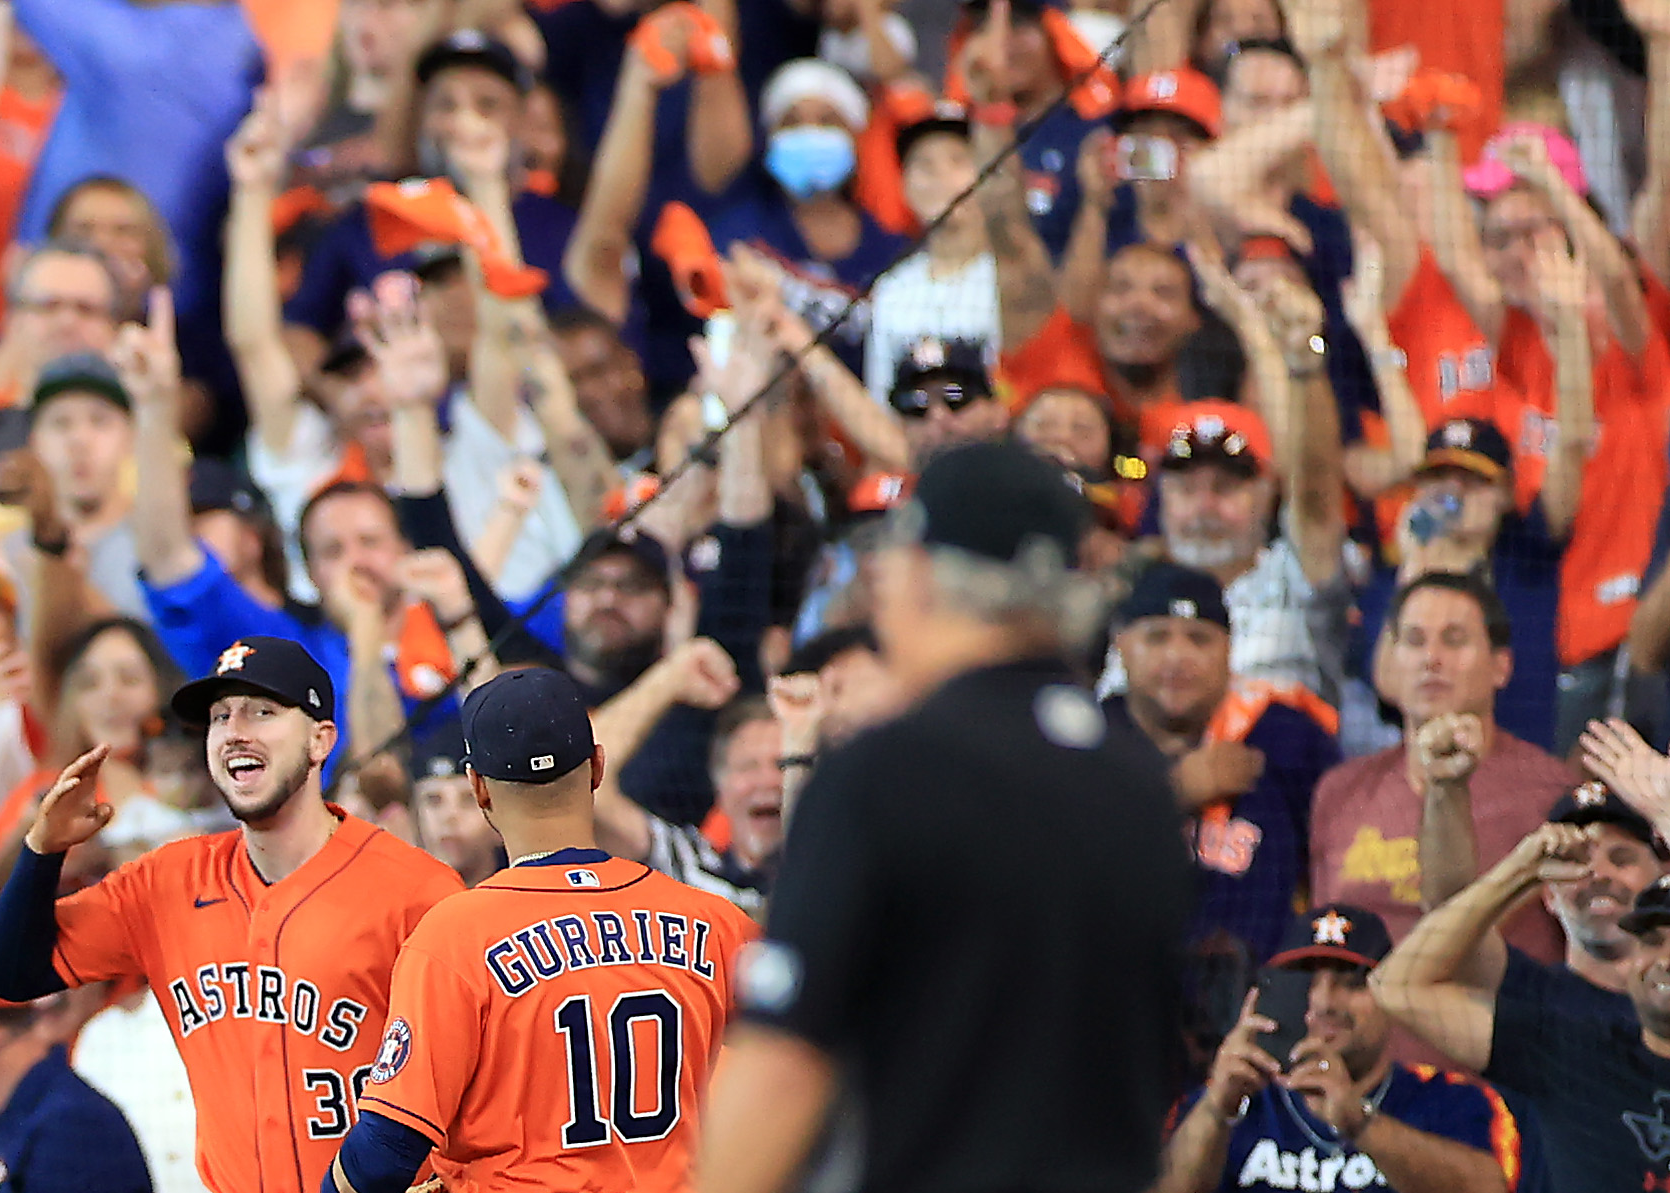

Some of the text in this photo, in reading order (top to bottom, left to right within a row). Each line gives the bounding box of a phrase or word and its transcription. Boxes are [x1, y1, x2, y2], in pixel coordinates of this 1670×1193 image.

[484, 909, 716, 998] GURRIEL
[168, 961, 368, 1052] ASTROS
[553, 988, 683, 1149] 10
